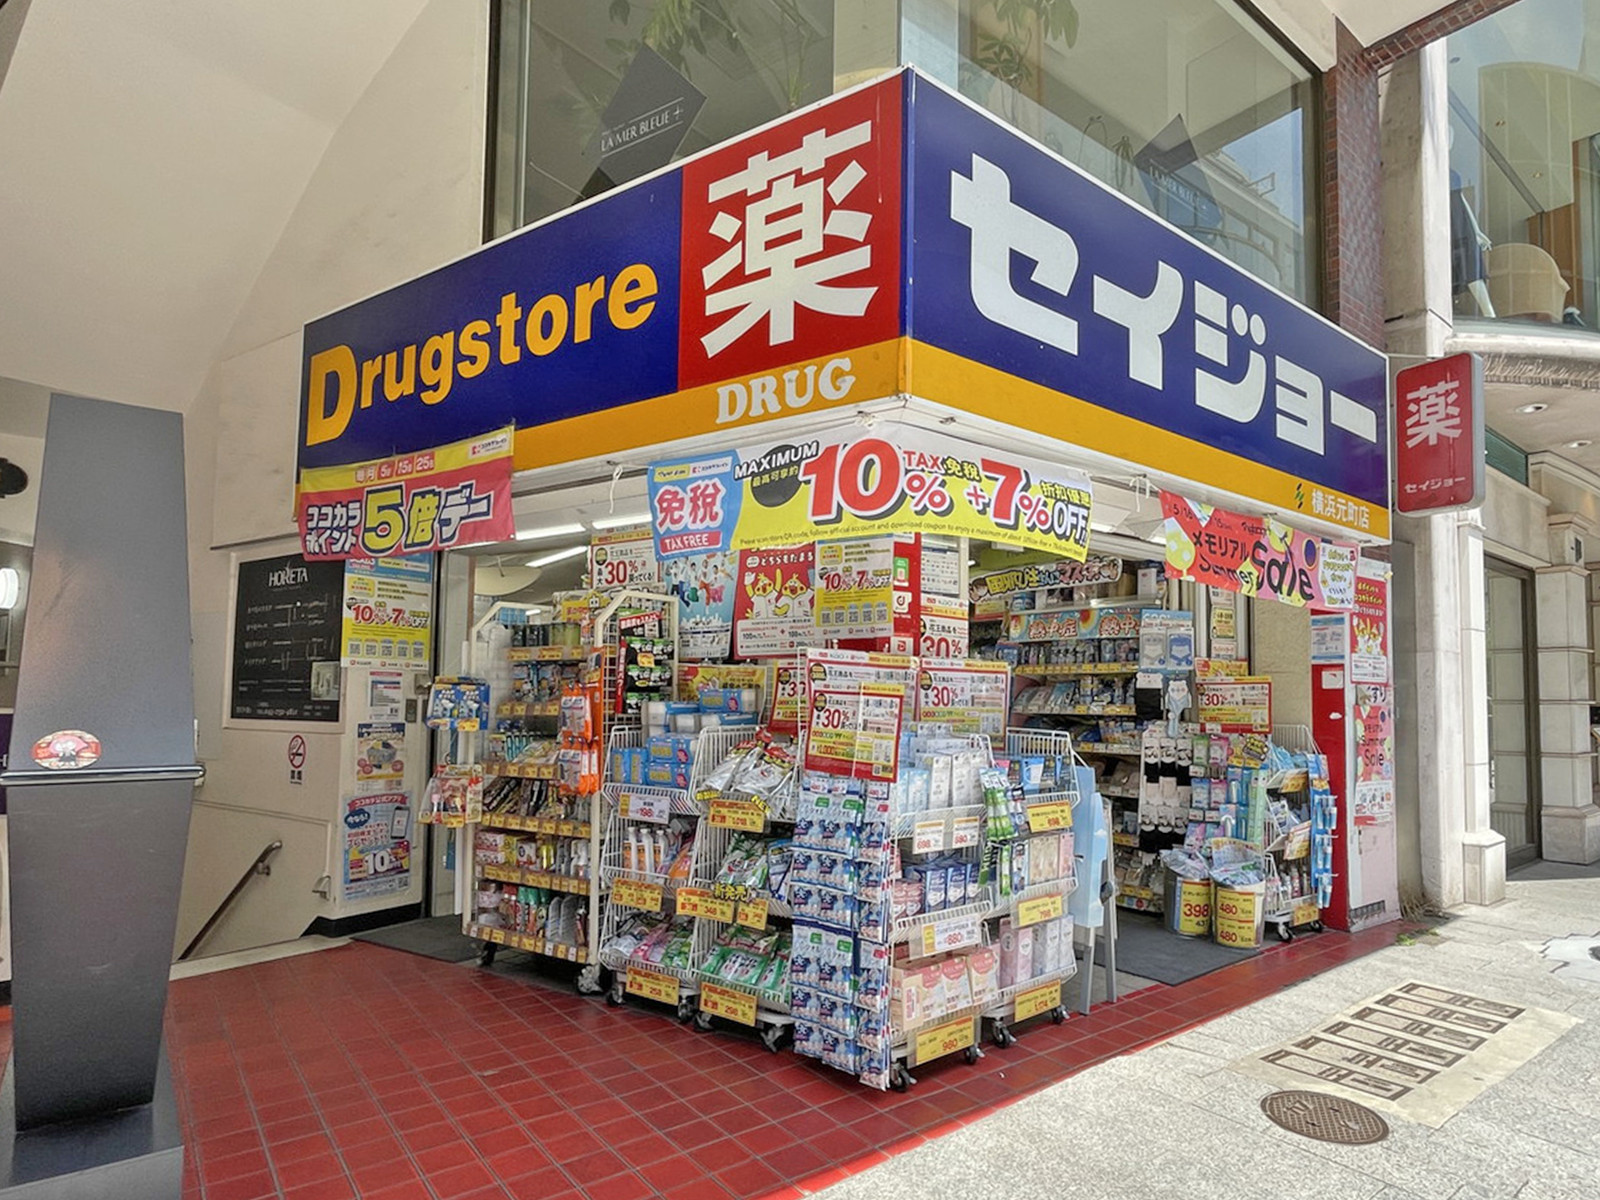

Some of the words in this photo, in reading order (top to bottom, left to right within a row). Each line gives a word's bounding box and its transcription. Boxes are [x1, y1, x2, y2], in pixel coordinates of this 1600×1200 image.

[602, 137, 614, 151] LA
[614, 127, 637, 146] MER
[639, 112, 669, 135] BLEUE
[701, 120, 879, 358] 薬
[950, 153, 1377, 456] セイジョー
[306, 263, 658, 447] Drugstore
[715, 358, 855, 424] DRUG
[1405, 380, 1462, 448] 薬
[735, 442, 818, 480] MAXIMUM
[903, 450, 942, 471] TAX
[1405, 476, 1466, 494] セイジョー
[307, 502, 361, 528] ココカラ
[656, 481, 723, 529] 免税
[306, 528, 357, 554] ポイント
[664, 536, 683, 551] TAX
[683, 534, 709, 547] FREE
[1192, 530, 1249, 561] メモリアル
[1252, 538, 1315, 601] Sale
[1364, 750, 1385, 767] Sale
[1183, 903, 1209, 917] 398
[1220, 903, 1238, 915] 480
[1220, 930, 1238, 942] 480
